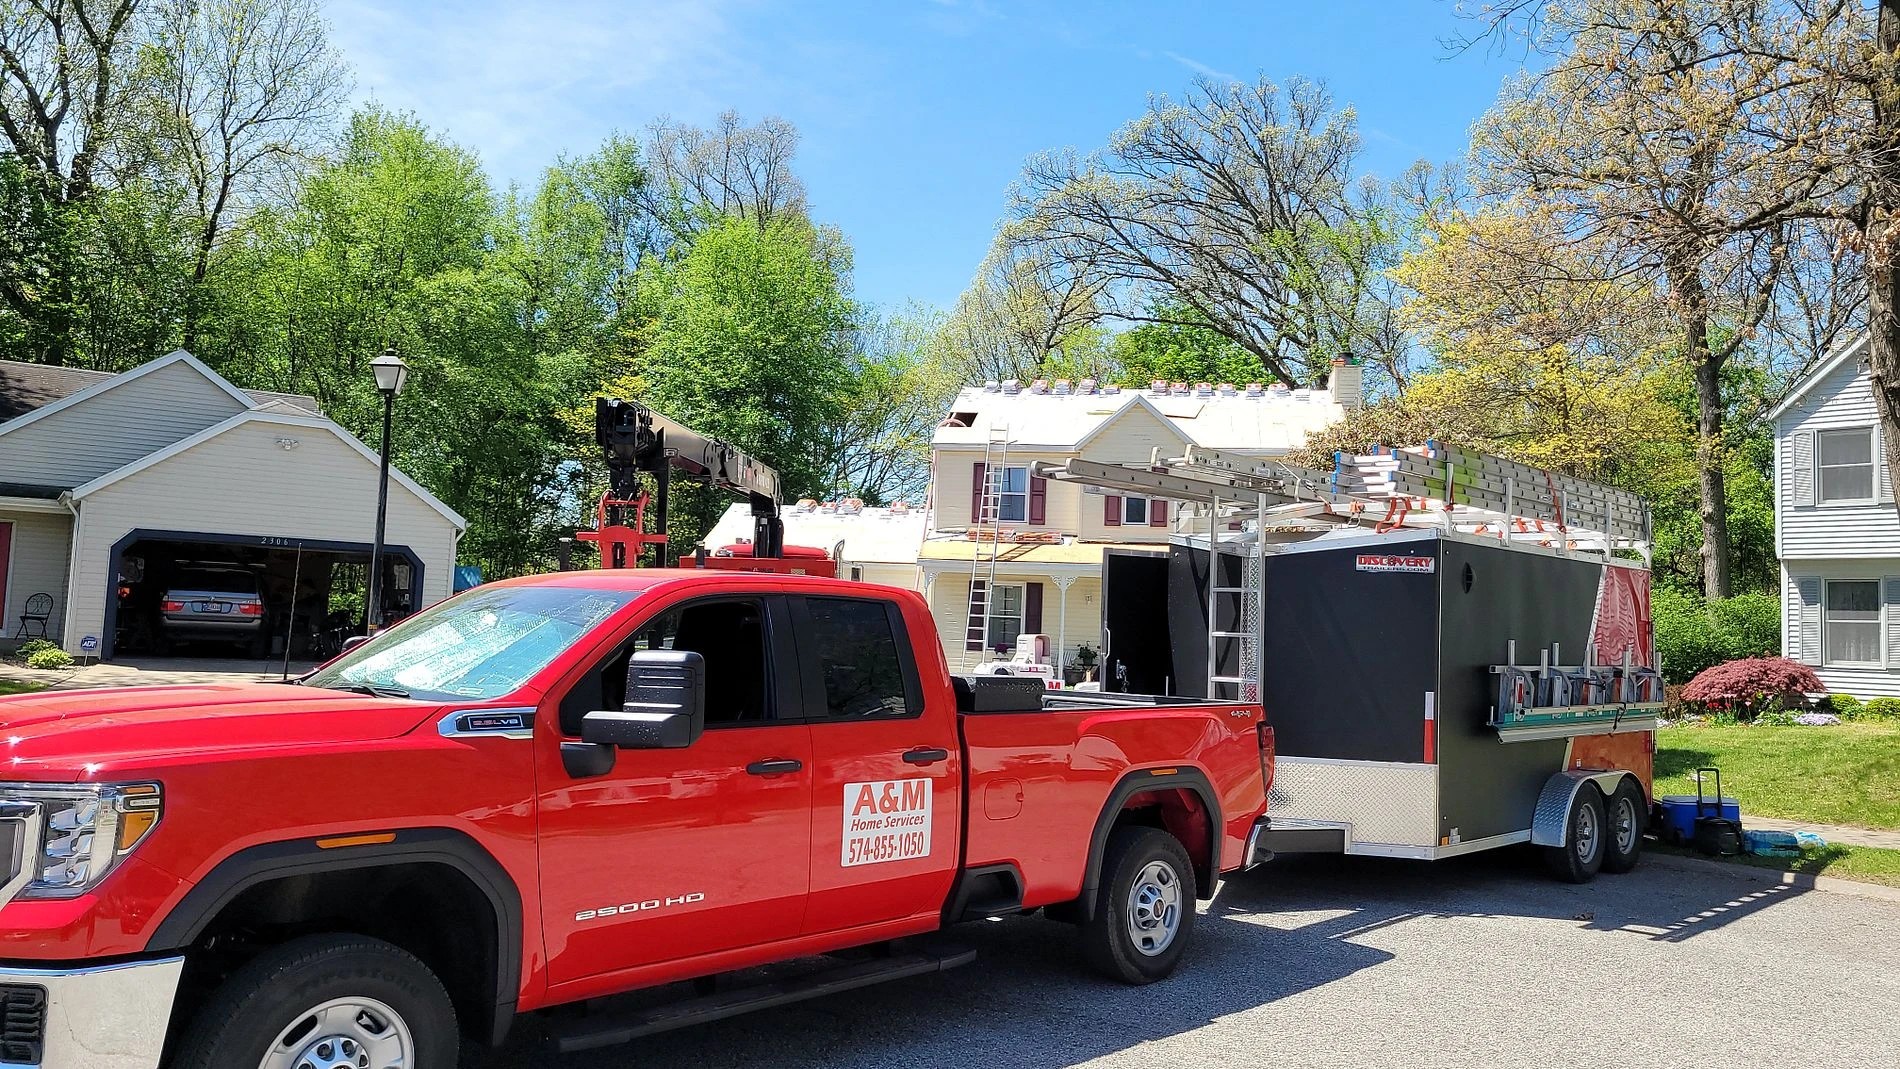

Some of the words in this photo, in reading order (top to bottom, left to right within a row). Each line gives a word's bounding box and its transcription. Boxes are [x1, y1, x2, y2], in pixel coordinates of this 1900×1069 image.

[261, 537, 288, 546] 2306
[1358, 556, 1433, 567] DISCOVERY
[852, 781, 925, 816] A&M
[851, 819, 882, 832] Home
[884, 814, 925, 828] Services
[849, 831, 924, 864] 574-855-1050
[575, 899, 660, 921] 2500
[665, 892, 705, 906] HD
